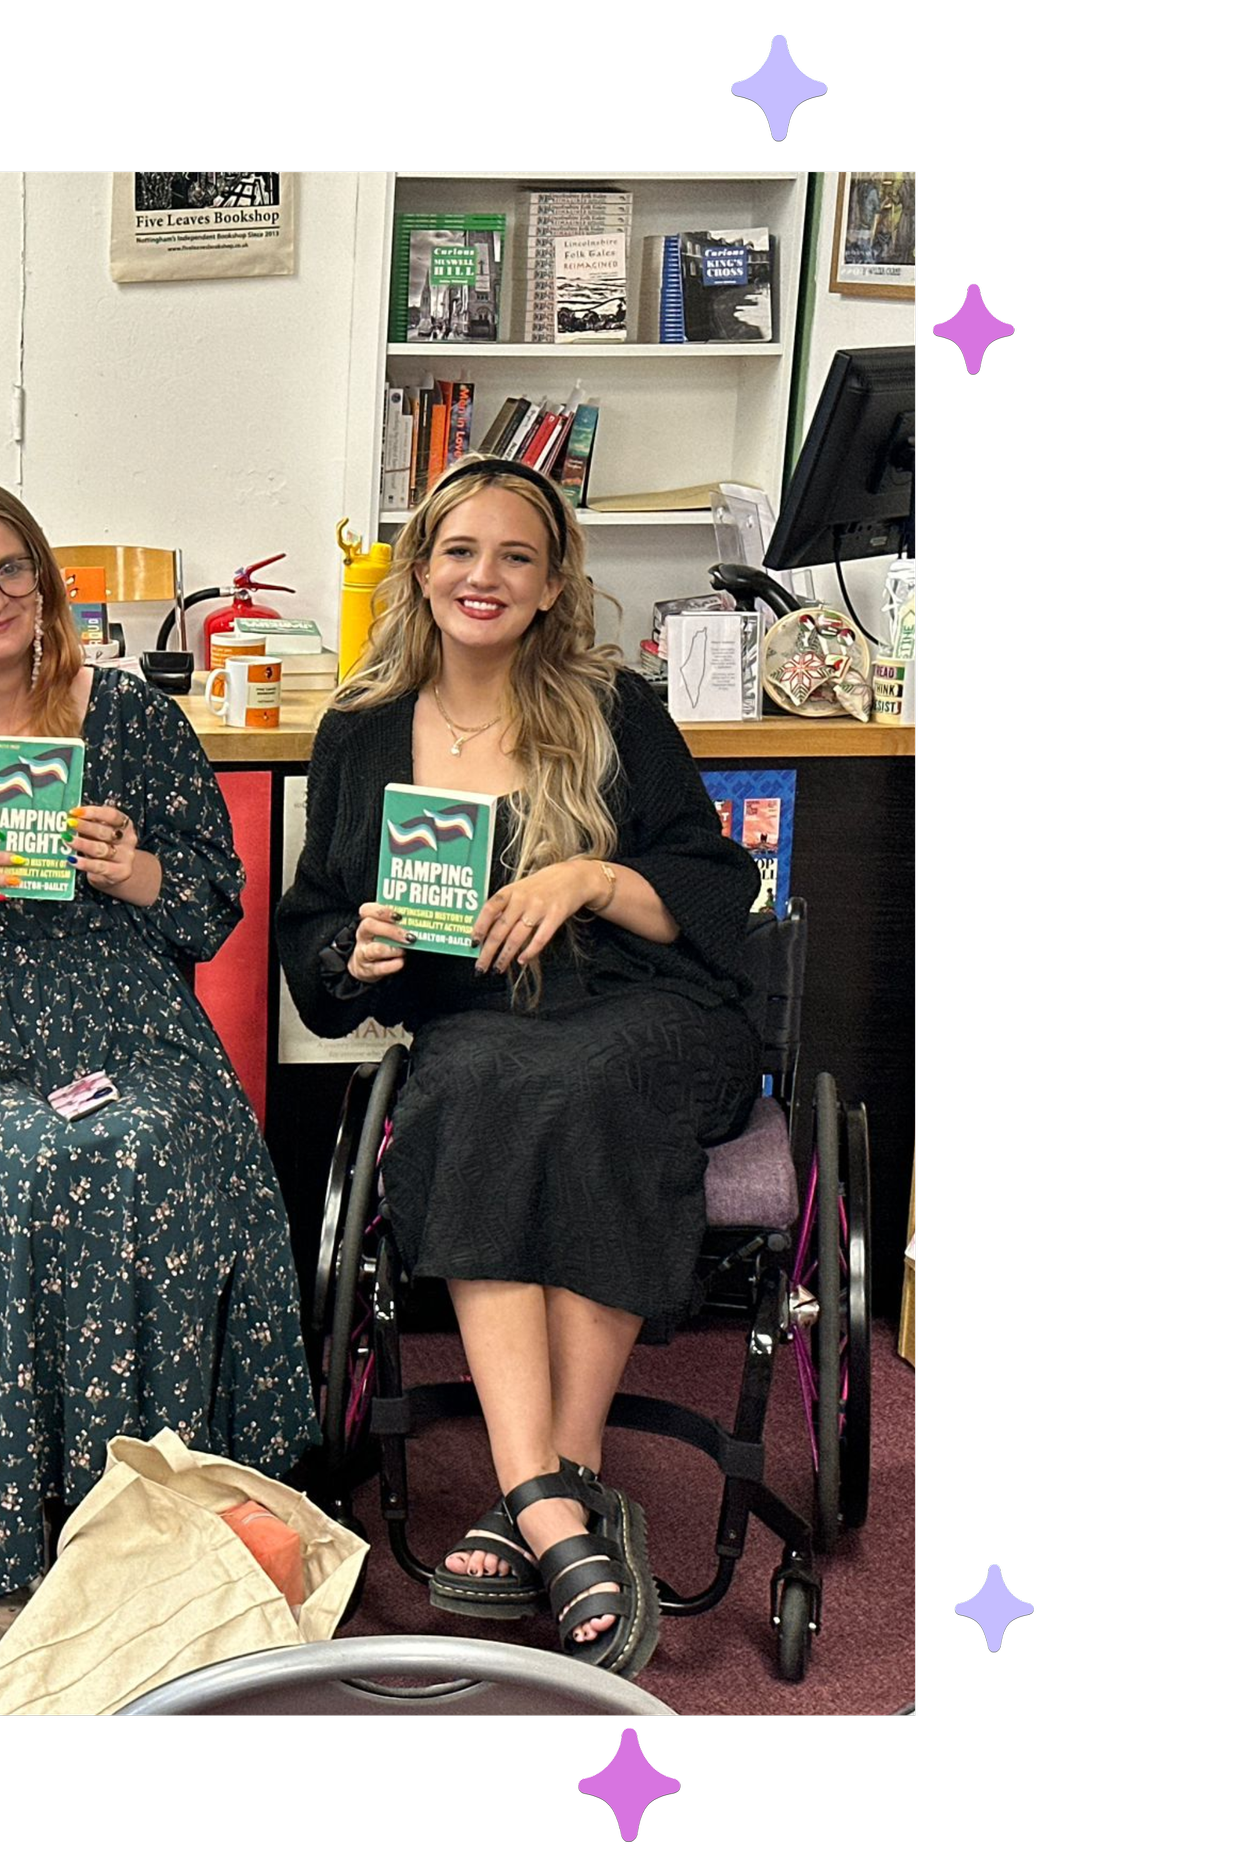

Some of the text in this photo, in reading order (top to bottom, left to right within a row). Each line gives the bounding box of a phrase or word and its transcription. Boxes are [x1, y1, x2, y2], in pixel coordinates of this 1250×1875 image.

[136, 209, 279, 227] Five Leaves Bookshop
[177, 234, 216, 242] Independent
[564, 240, 617, 248] Lincolnshire
[565, 250, 585, 259] Folk
[704, 249, 744, 257] Curious
[564, 260, 618, 269] REIMAGINED
[706, 259, 743, 268] KING'S
[434, 266, 474, 275] HILL
[706, 268, 744, 277] CROSS
[458, 388, 470, 414] Men
[454, 430, 465, 459] Love
[31, 858, 59, 867] HISTORY
[40, 868, 71, 878] ACTIVISM
[391, 857, 473, 888] RAMPING
[382, 878, 479, 911] UP RIGHTS
[435, 911, 462, 922] HISTORY
[464, 915, 474, 923] OF
[408, 918, 444, 930] DISABILITY
